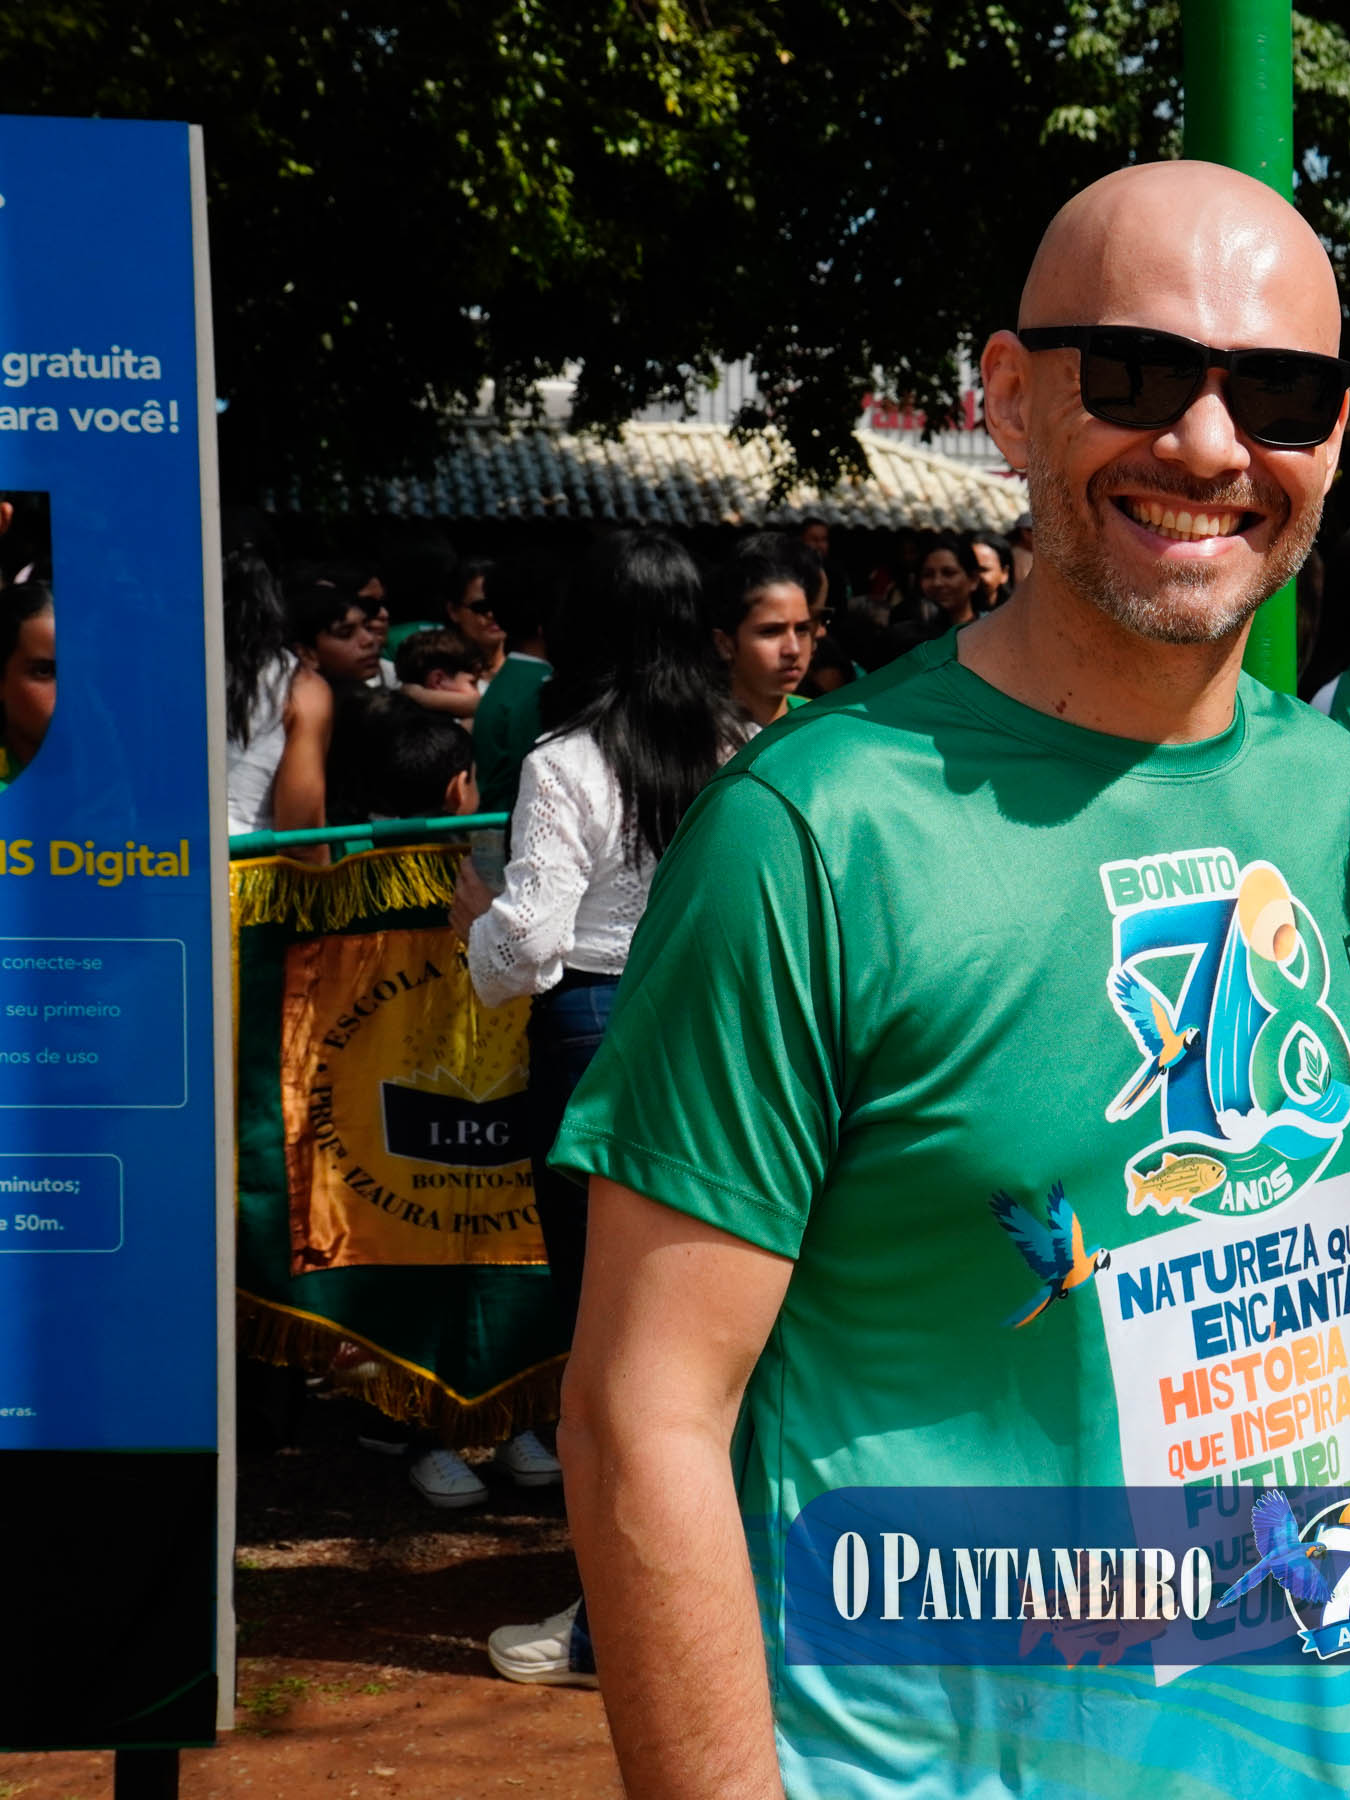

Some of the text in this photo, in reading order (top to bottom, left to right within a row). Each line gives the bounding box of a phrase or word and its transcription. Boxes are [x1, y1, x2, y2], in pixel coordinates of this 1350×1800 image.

[2, 345, 161, 387] gratuita
[69, 400, 180, 433] você!
[50, 839, 190, 887] Digital
[1106, 855, 1236, 906] BONITO
[2, 955, 103, 971] conecte-se
[6, 1001, 121, 1022] seu primeiro
[323, 959, 443, 1051] ESCOLA
[36, 1048, 60, 1064] de
[66, 1051, 98, 1064] uso
[343, 1165, 441, 1232] IZAURA
[1219, 1161, 1295, 1212] ANOS
[14, 1214, 65, 1232] 50m.
[1117, 1222, 1320, 1321] NATUREZA
[1168, 1431, 1227, 1480] QUE
[1184, 1434, 1341, 1529] FUTURO
